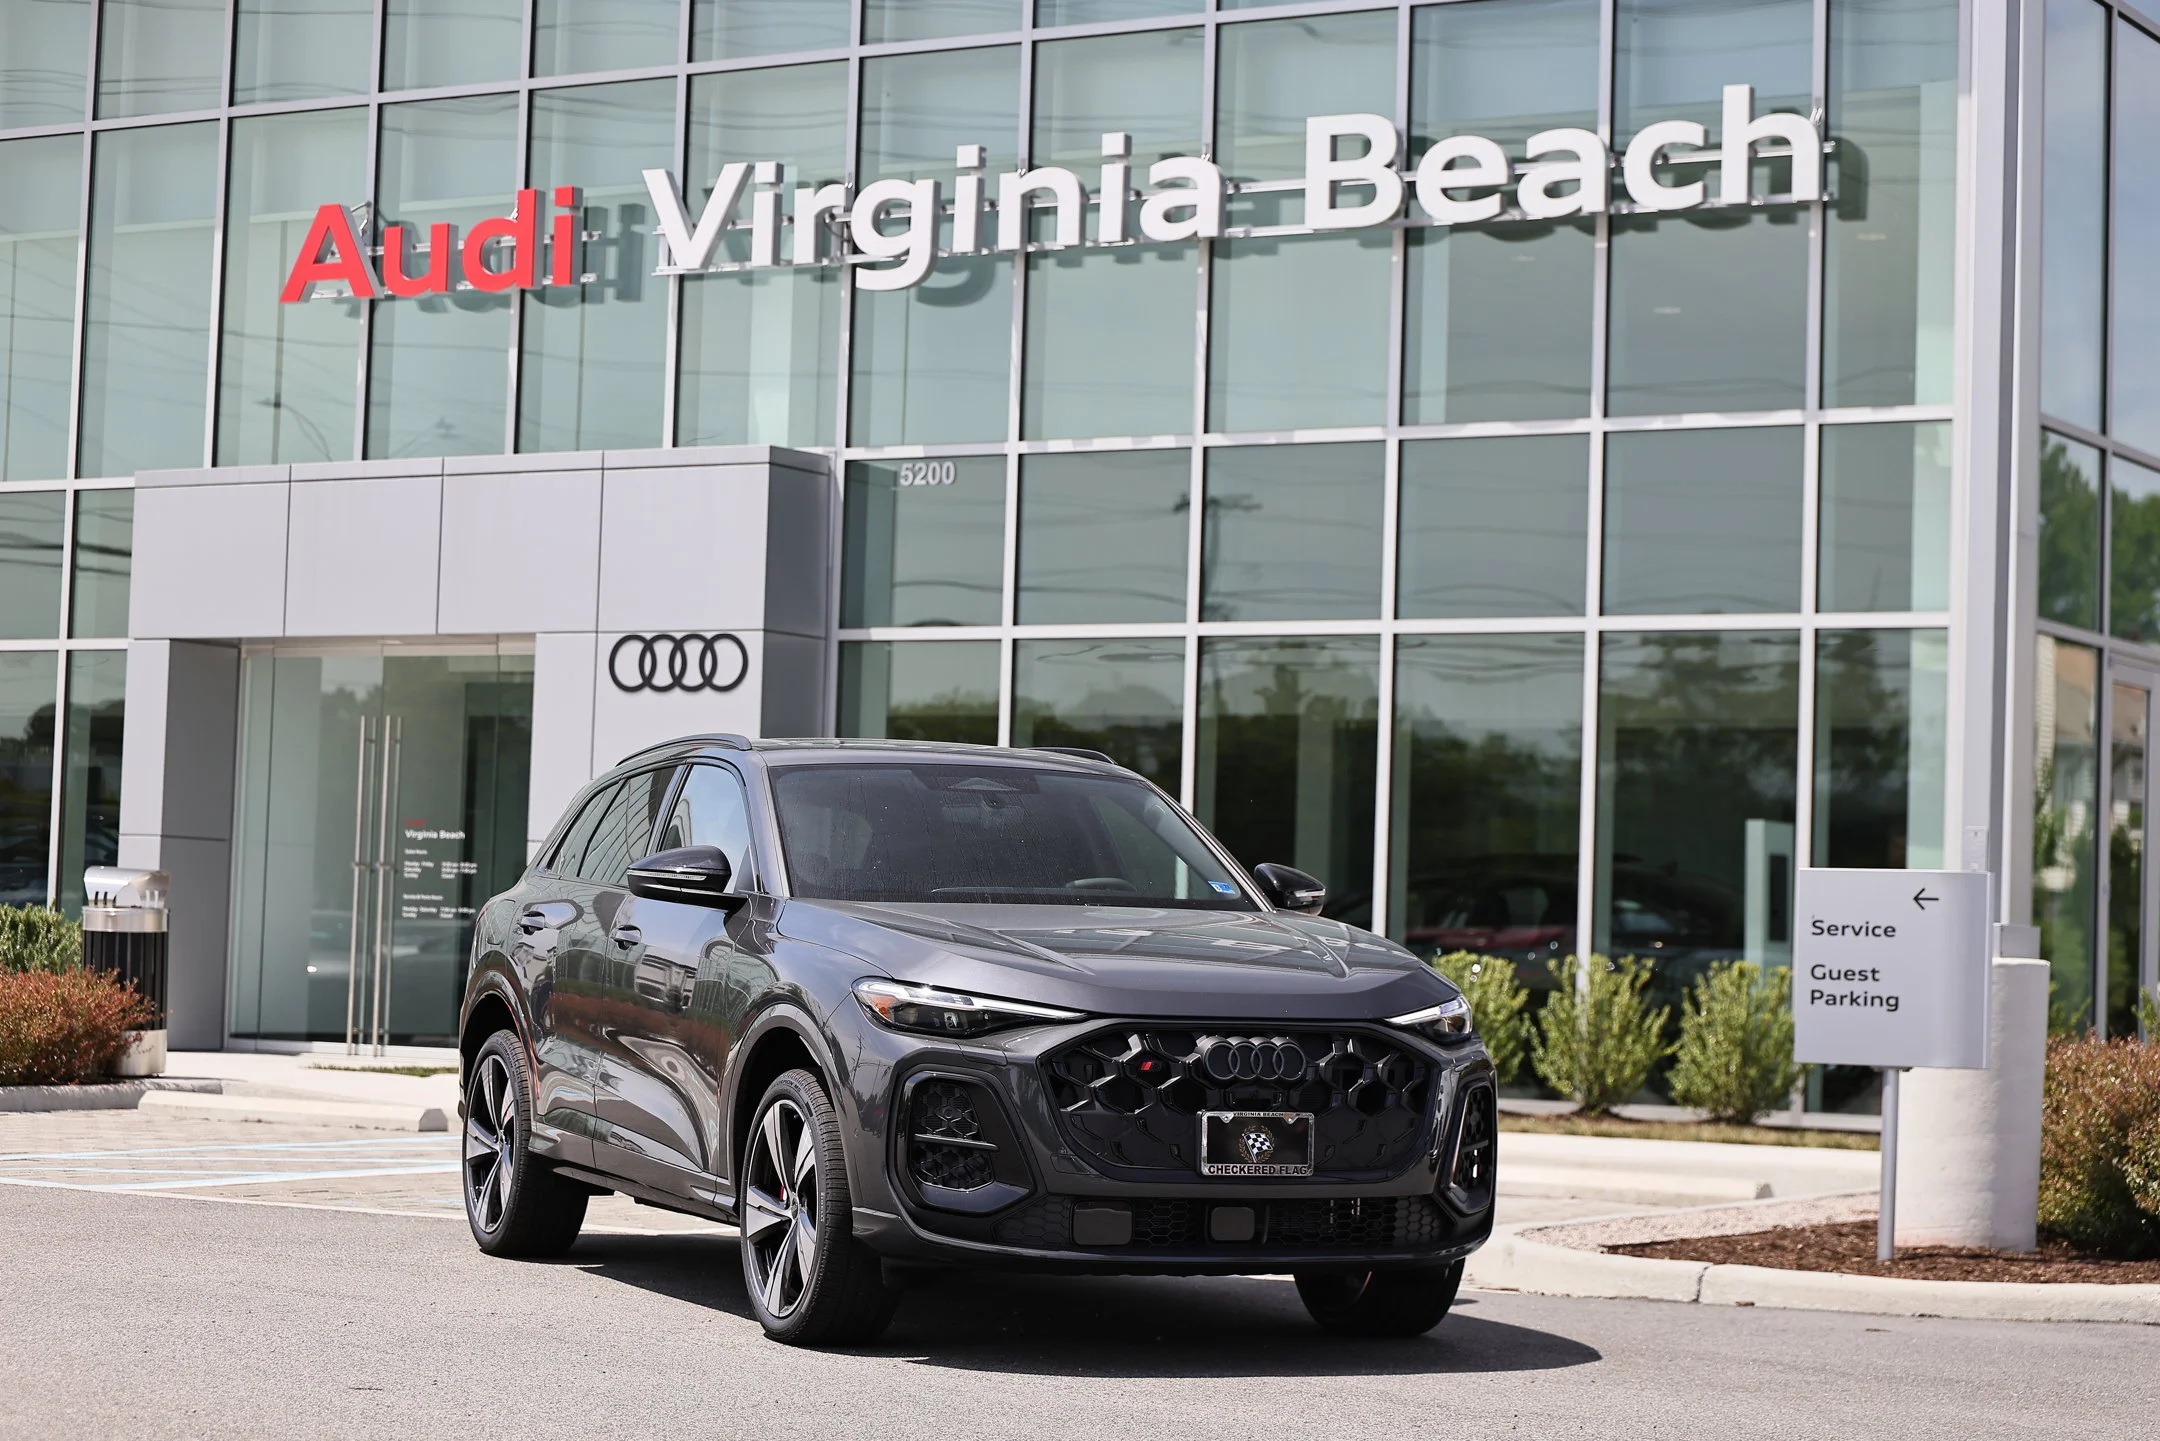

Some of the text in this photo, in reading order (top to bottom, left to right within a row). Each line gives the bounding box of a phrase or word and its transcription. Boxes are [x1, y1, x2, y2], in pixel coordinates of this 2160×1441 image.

[280, 84, 1824, 302] Audi Virginia Beach
[900, 461, 956, 487] 5200
[404, 829, 465, 840] Virginia Beach
[1811, 919, 1896, 938] Service
[1810, 964, 1880, 982] Guest
[1810, 989, 1899, 1012] Parking
[1207, 1164, 1308, 1175] CHECKERED FLAG
